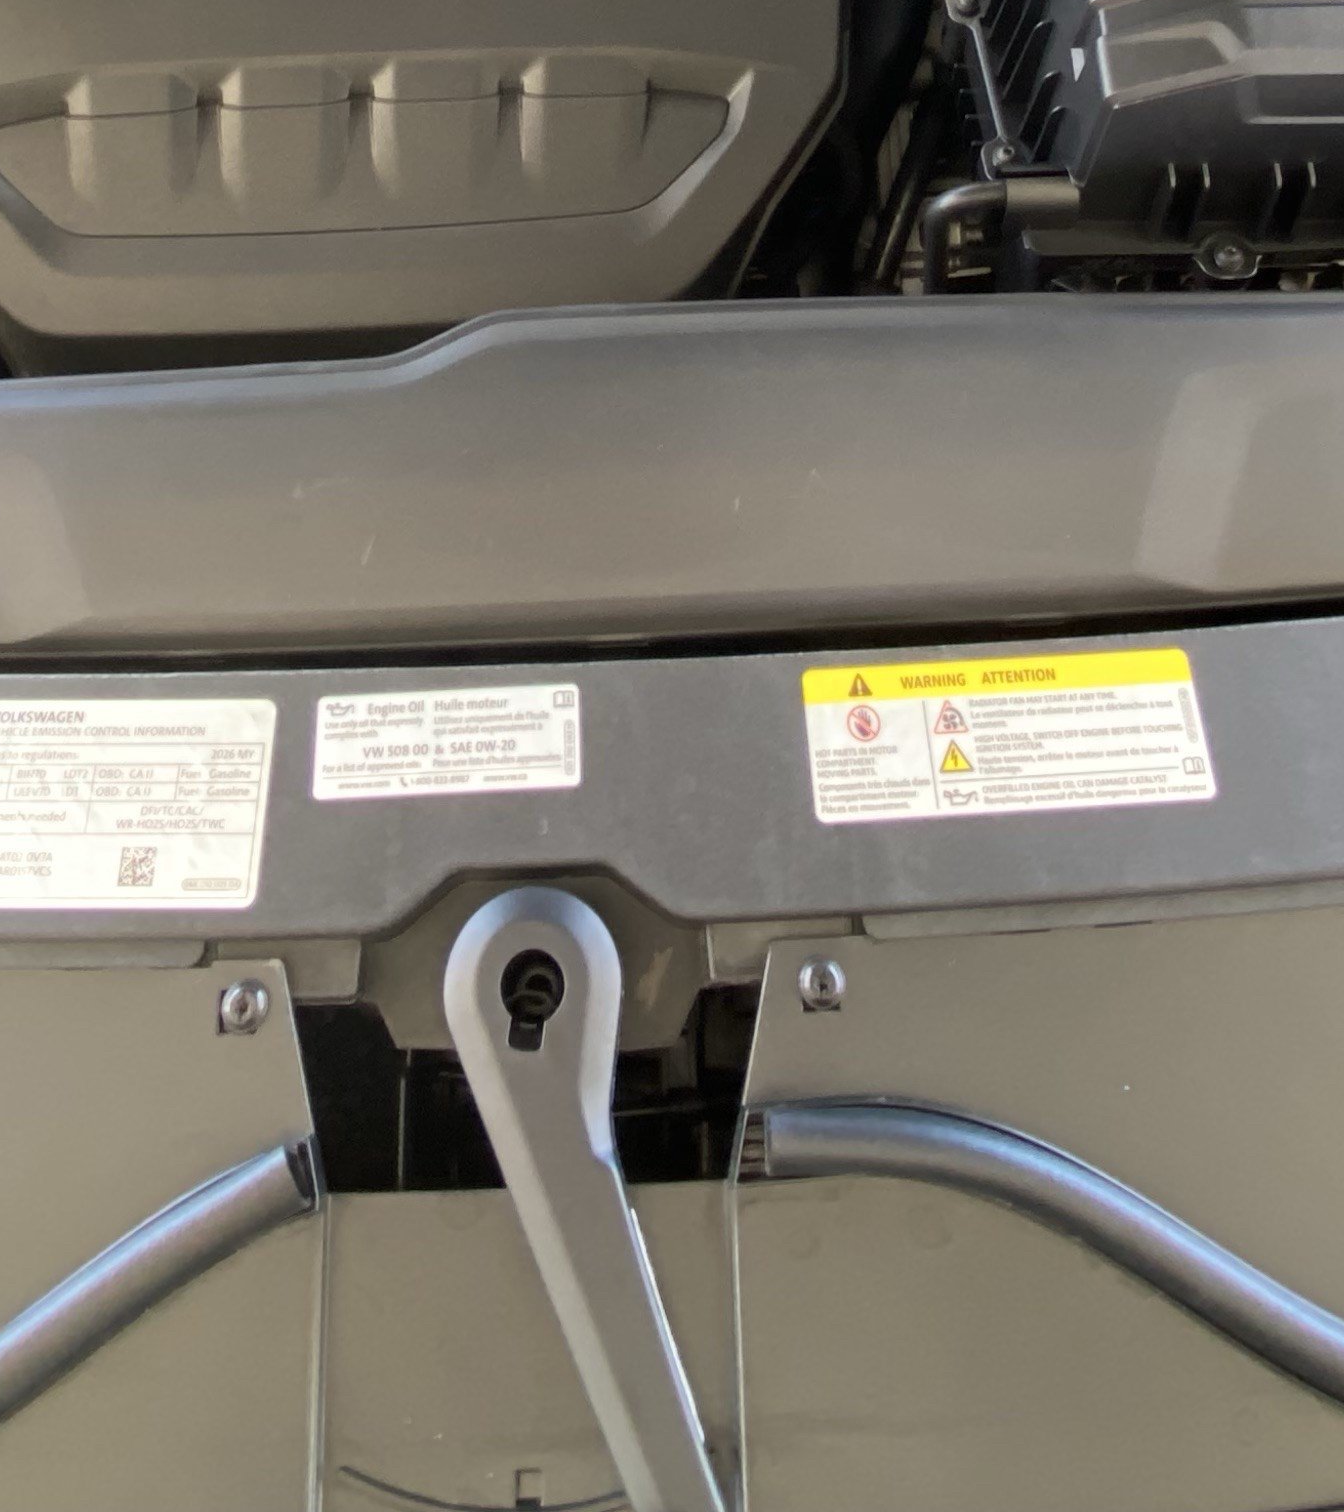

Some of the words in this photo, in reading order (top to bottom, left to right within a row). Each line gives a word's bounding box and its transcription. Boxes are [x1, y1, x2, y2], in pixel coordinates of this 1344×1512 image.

[900, 673, 967, 689] WARNING
[982, 668, 1056, 685] ATTENTION
[434, 699, 464, 711] Huile
[467, 698, 509, 710] moteur
[1009, 696, 1025, 705] FAN
[1026, 696, 1042, 704] MAY
[1044, 694, 1067, 703] START
[1069, 693, 1077, 701] AT
[1080, 692, 1095, 701] ANY
[368, 702, 405, 717] Engine
[408, 700, 425, 713] Oil
[32, 726, 81, 737] EMISSION
[84, 726, 130, 737] CONTROL
[134, 726, 206, 737] INFORMATION
[1032, 731, 1063, 740] SWITCH
[1064, 730, 1079, 738] OFF
[1080, 728, 1109, 737] ENGINE
[1111, 726, 1142, 736] BEFORE
[211, 749, 235, 760] 2026
[238, 749, 255, 760] MY
[363, 746, 384, 758] VW
[388, 744, 409, 757] 508
[412, 744, 429, 756] 00
[435, 744, 444, 755] &
[450, 742, 473, 754] SAE
[476, 740, 517, 753] 0W-20
[832, 748, 857, 757] PARTS
[869, 745, 898, 755] MOTOR
[209, 768, 251, 779] Gasoline
[1031, 781, 1061, 791] ENGINE
[1077, 779, 1094, 788] CAN
[1095, 776, 1128, 787] DAMAGE
[207, 786, 250, 797] Gasoline
